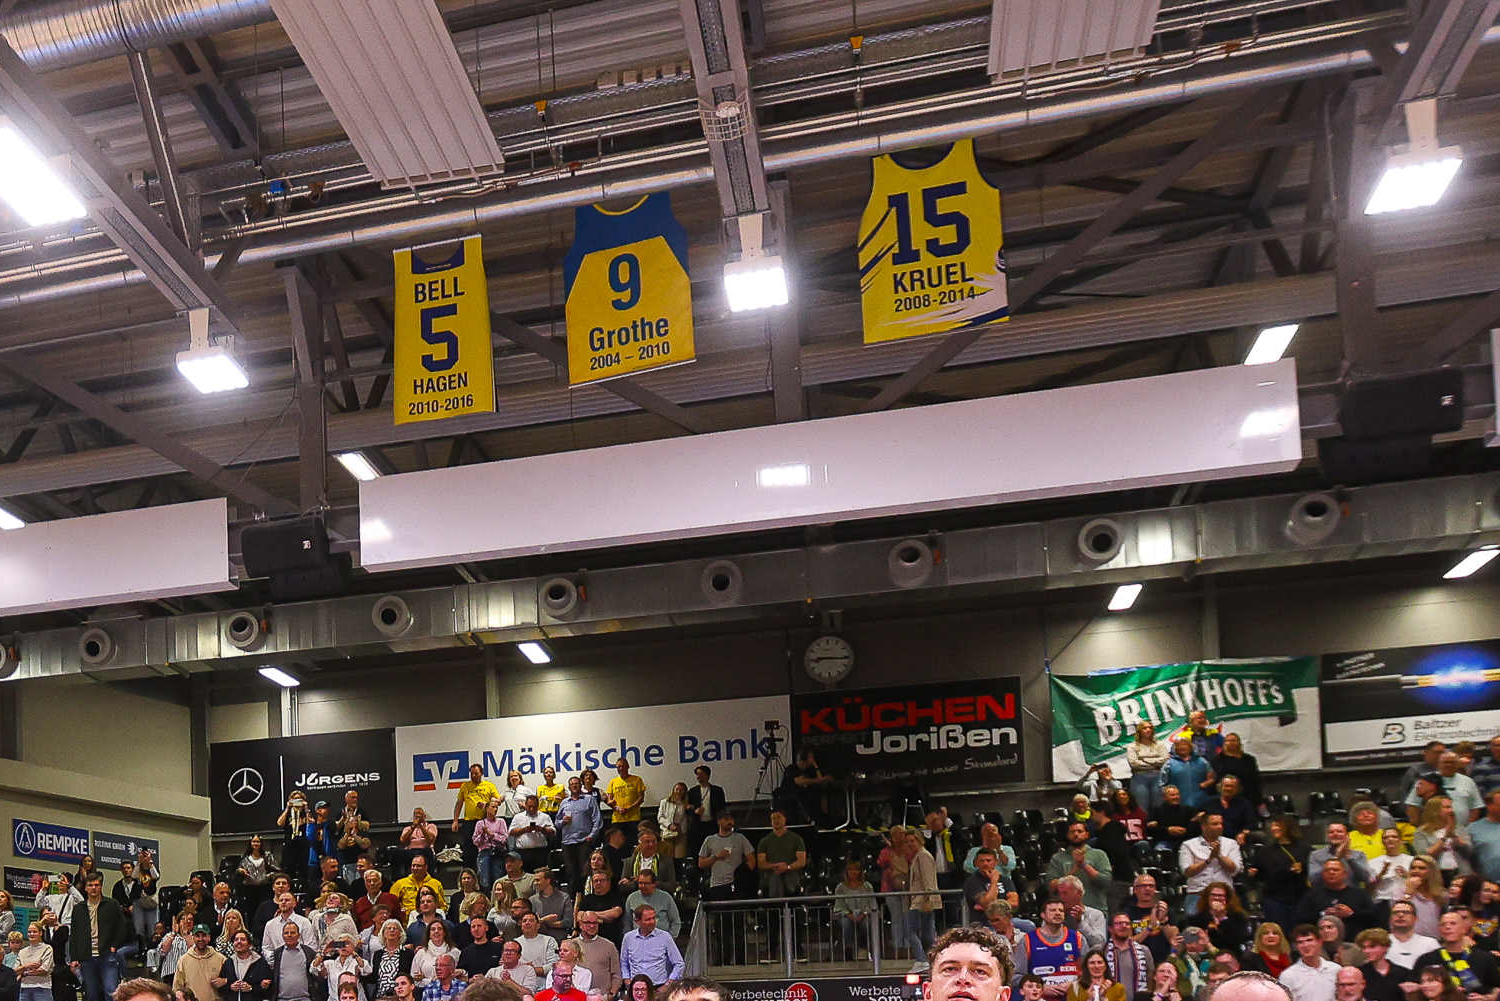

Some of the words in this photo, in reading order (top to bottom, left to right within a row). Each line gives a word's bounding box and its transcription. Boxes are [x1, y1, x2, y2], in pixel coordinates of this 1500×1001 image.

[887, 181, 971, 265] 15
[414, 276, 465, 304] BELL
[608, 253, 641, 311] 9
[891, 261, 975, 294] KRUEL
[893, 286, 977, 314] 2008-2014
[420, 303, 459, 372] 5
[589, 316, 670, 352] Grothe
[589, 353, 621, 371] 2004
[638, 341, 670, 362] 2010
[413, 371, 469, 395] HAGEN
[408, 394, 474, 416] 2010-2016
[801, 692, 1016, 734] KÜCHEN
[482, 738, 664, 778] Märkische
[678, 728, 771, 765] Bank
[802, 731, 868, 746] PERFEKT
[856, 724, 1018, 755] Jorißen
[295, 772, 381, 787] JÜRGENS
[37, 832, 88, 855] REMPKE
